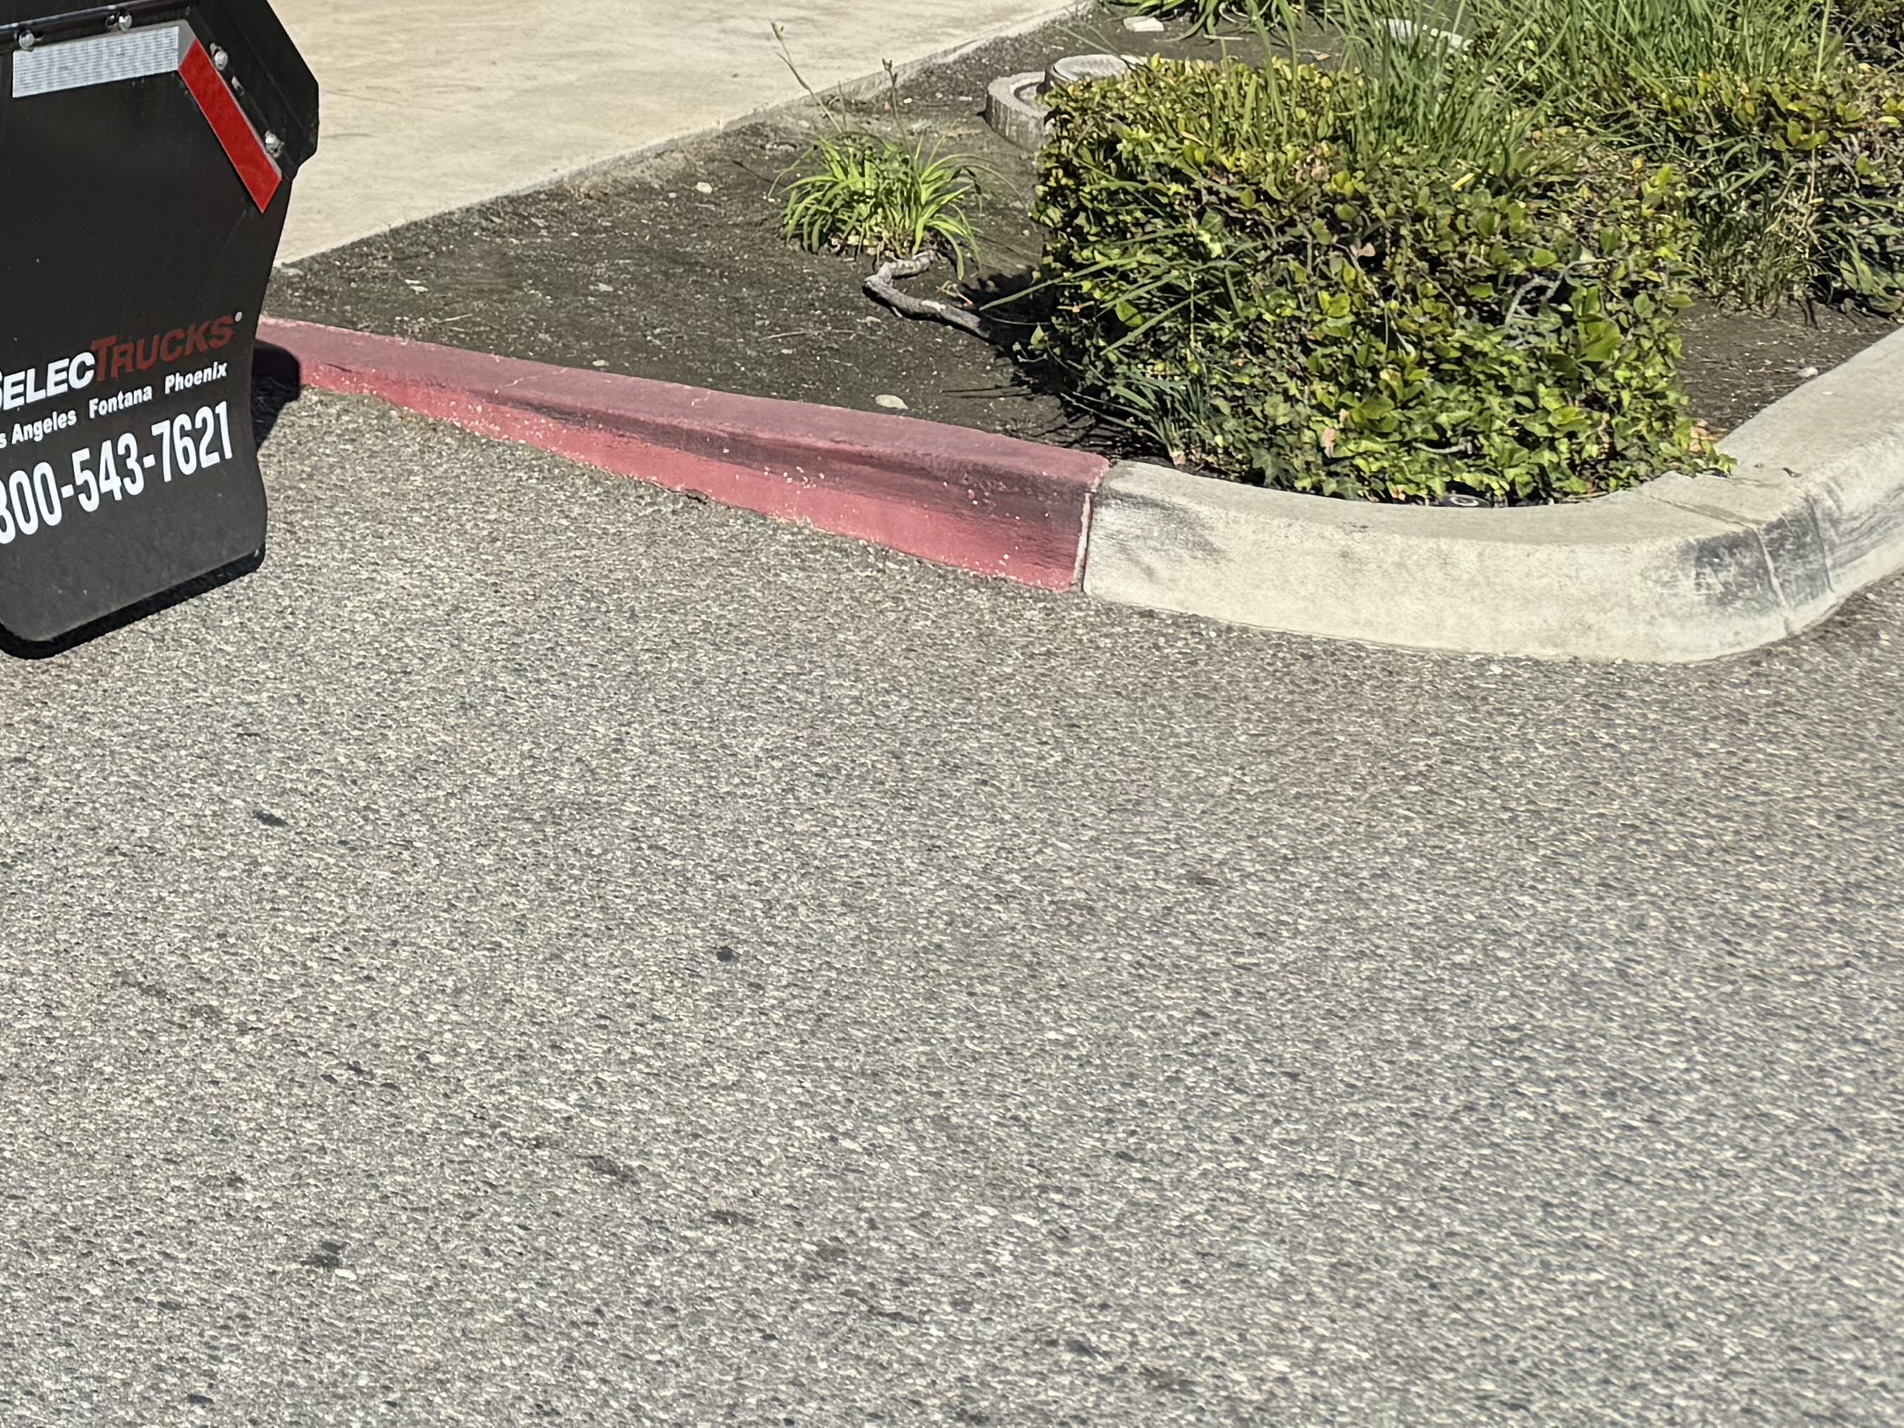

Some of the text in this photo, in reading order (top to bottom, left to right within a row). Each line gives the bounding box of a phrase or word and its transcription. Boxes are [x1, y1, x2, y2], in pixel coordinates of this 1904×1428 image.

[12, 408, 77, 445] Angeles
[89, 385, 152, 419] Fontana
[165, 361, 227, 394] Phoenix
